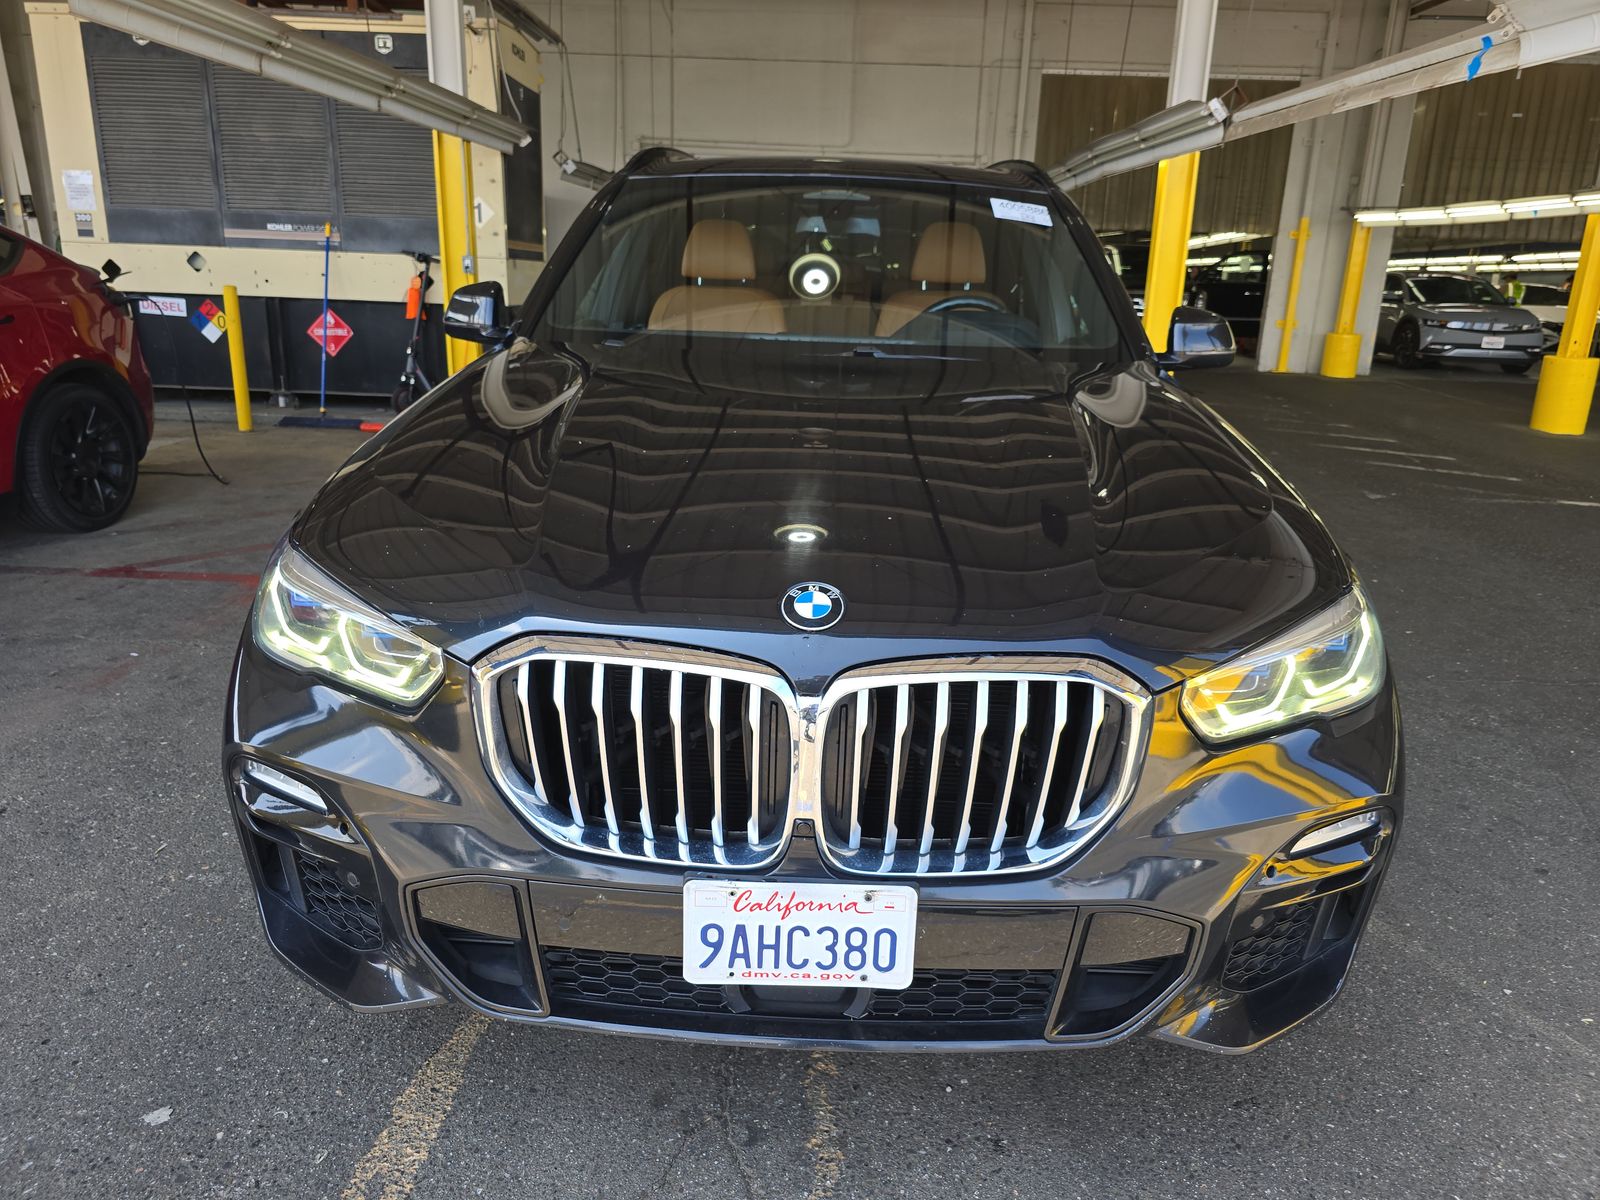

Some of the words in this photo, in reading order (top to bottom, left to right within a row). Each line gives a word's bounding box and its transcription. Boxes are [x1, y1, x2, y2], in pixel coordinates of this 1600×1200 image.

[473, 203, 482, 223] 1
[266, 223, 292, 231] KOHLER
[142, 300, 184, 313] DIESEL
[205, 302, 214, 317] 2
[217, 315, 226, 329] 0
[790, 584, 838, 599] BMW
[733, 889, 873, 920] California
[699, 923, 897, 973] 9AHC380
[741, 970, 855, 981] dmv.ca.gov
